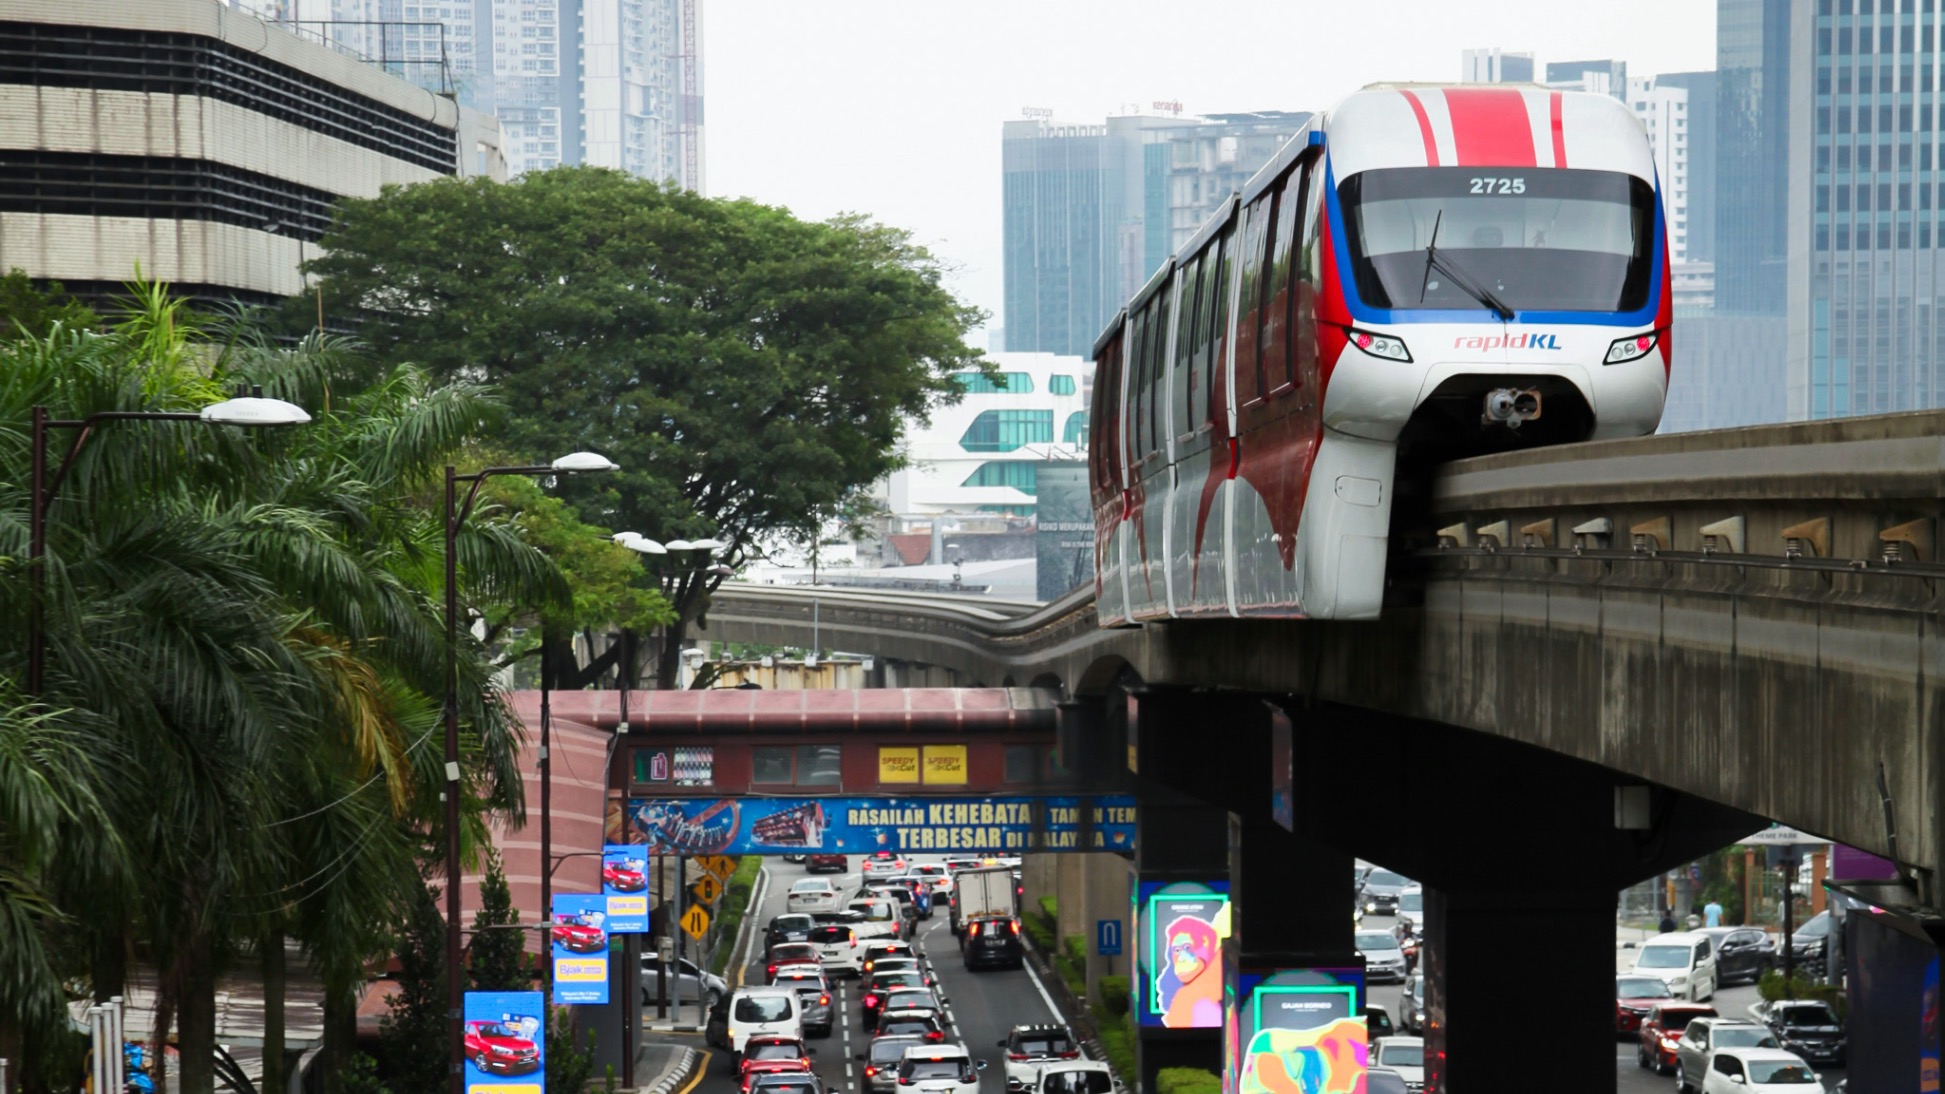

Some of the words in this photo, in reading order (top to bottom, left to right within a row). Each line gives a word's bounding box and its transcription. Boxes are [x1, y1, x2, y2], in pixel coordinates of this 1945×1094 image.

[1470, 177, 1526, 194] 2725
[1454, 333, 1562, 352] rapidKL
[848, 809, 924, 825] RASAILAH
[929, 804, 1036, 824] KEHEBATA
[1050, 808, 1103, 823] TAMN
[1107, 808, 1136, 823] TEM
[897, 828, 1001, 848] TERBESAR
[1006, 832, 1023, 848] DI
[560, 964, 582, 976] Bjak
